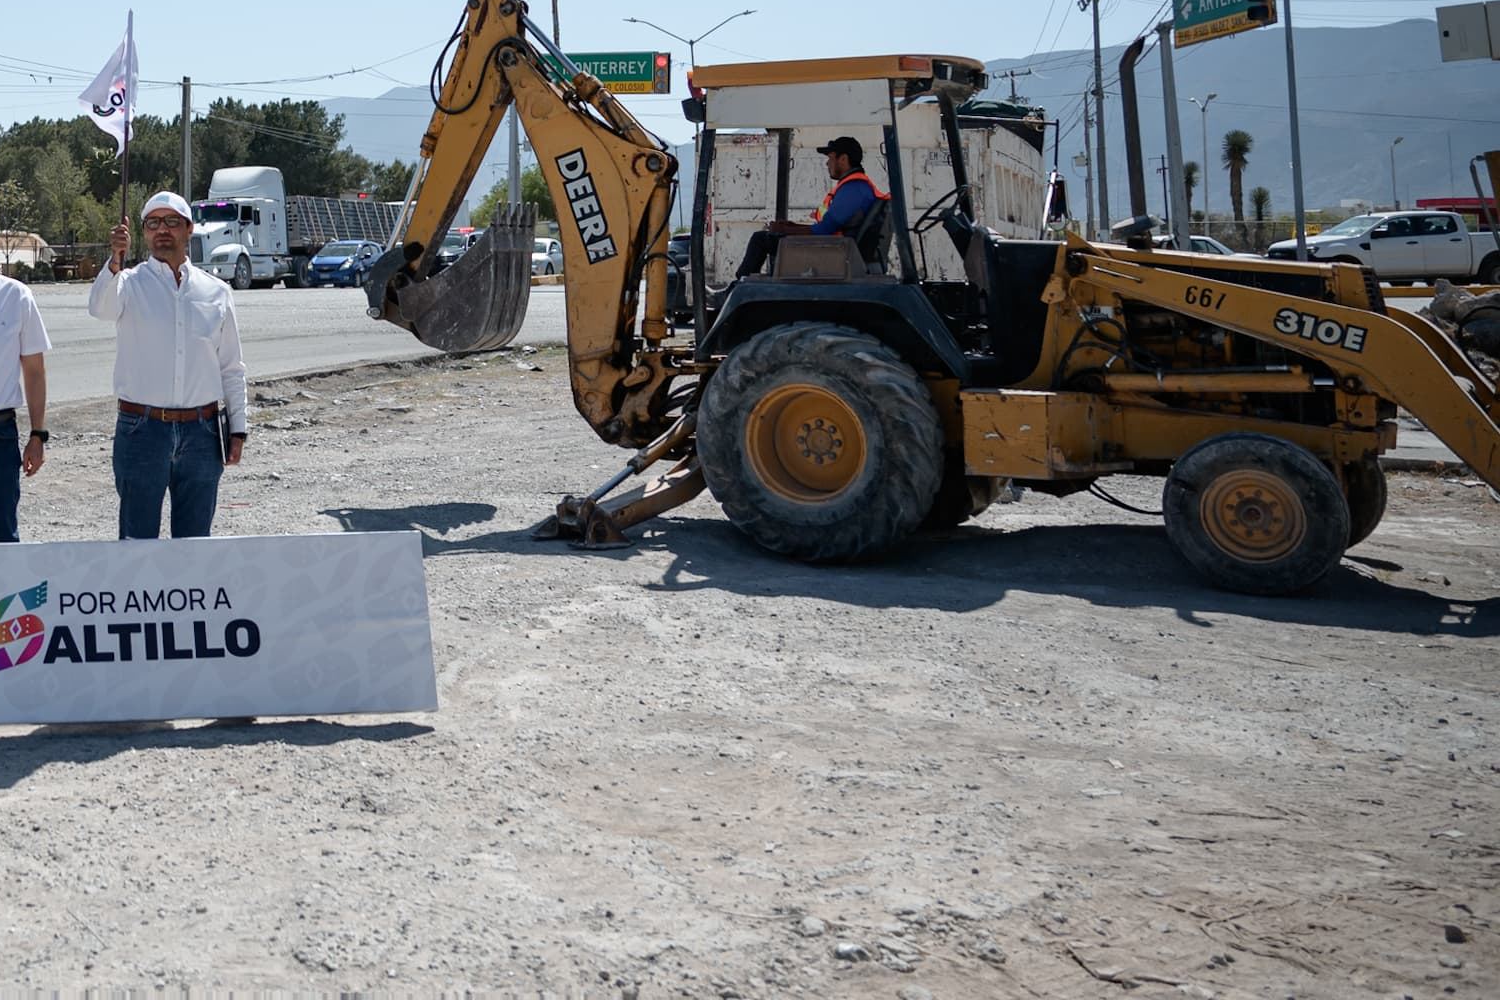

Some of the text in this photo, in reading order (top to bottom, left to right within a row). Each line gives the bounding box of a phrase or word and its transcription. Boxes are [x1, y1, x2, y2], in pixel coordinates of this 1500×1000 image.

[554, 147, 618, 265] DEERE
[1274, 308, 1368, 353] 310E
[59, 587, 232, 615] POR AMOR A
